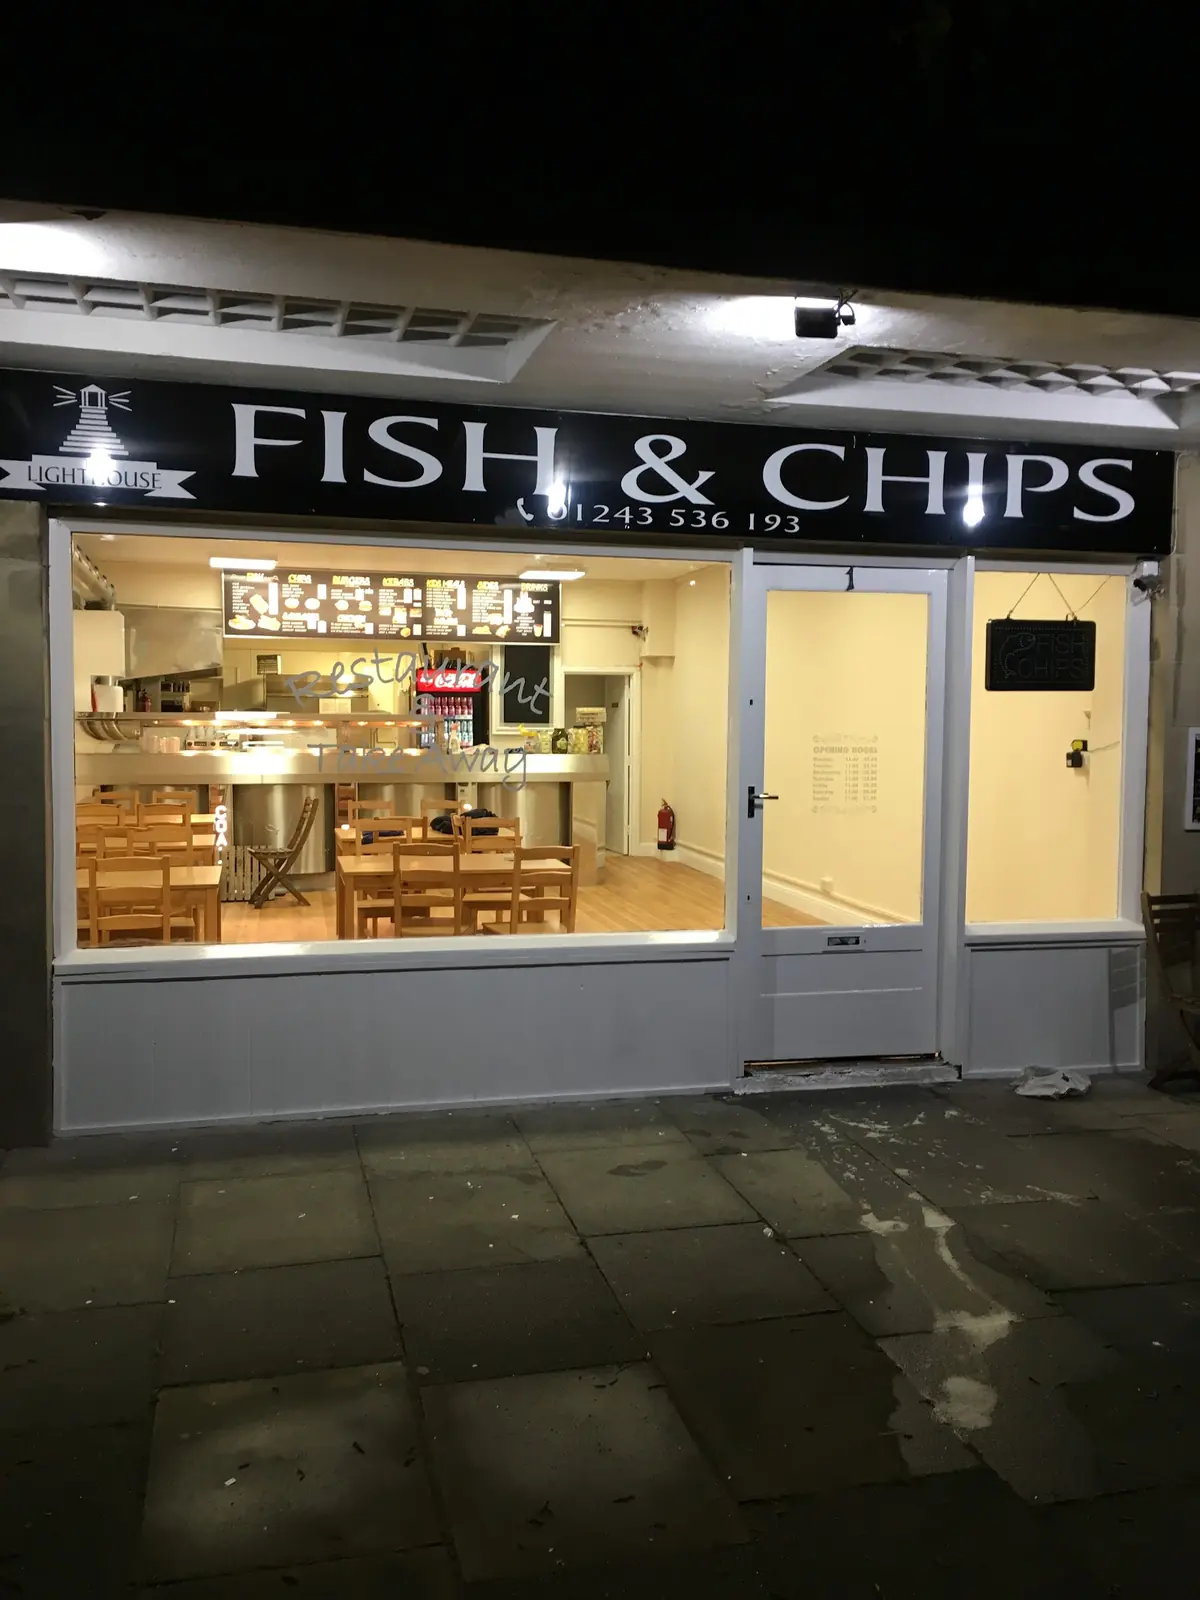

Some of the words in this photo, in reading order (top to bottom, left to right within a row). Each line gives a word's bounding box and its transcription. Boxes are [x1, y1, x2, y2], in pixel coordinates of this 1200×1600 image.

[231, 403, 560, 493] FISH
[620, 434, 716, 506] &
[762, 443, 1136, 522] CHIPS
[27, 465, 163, 489] LIGHTOUSE
[547, 502, 654, 526] 01243
[668, 508, 730, 530] 536
[748, 512, 801, 534] 193
[1036, 632, 1086, 656] FISH
[284, 647, 554, 716] Restaurant
[1018, 657, 1086, 679] CHIPS
